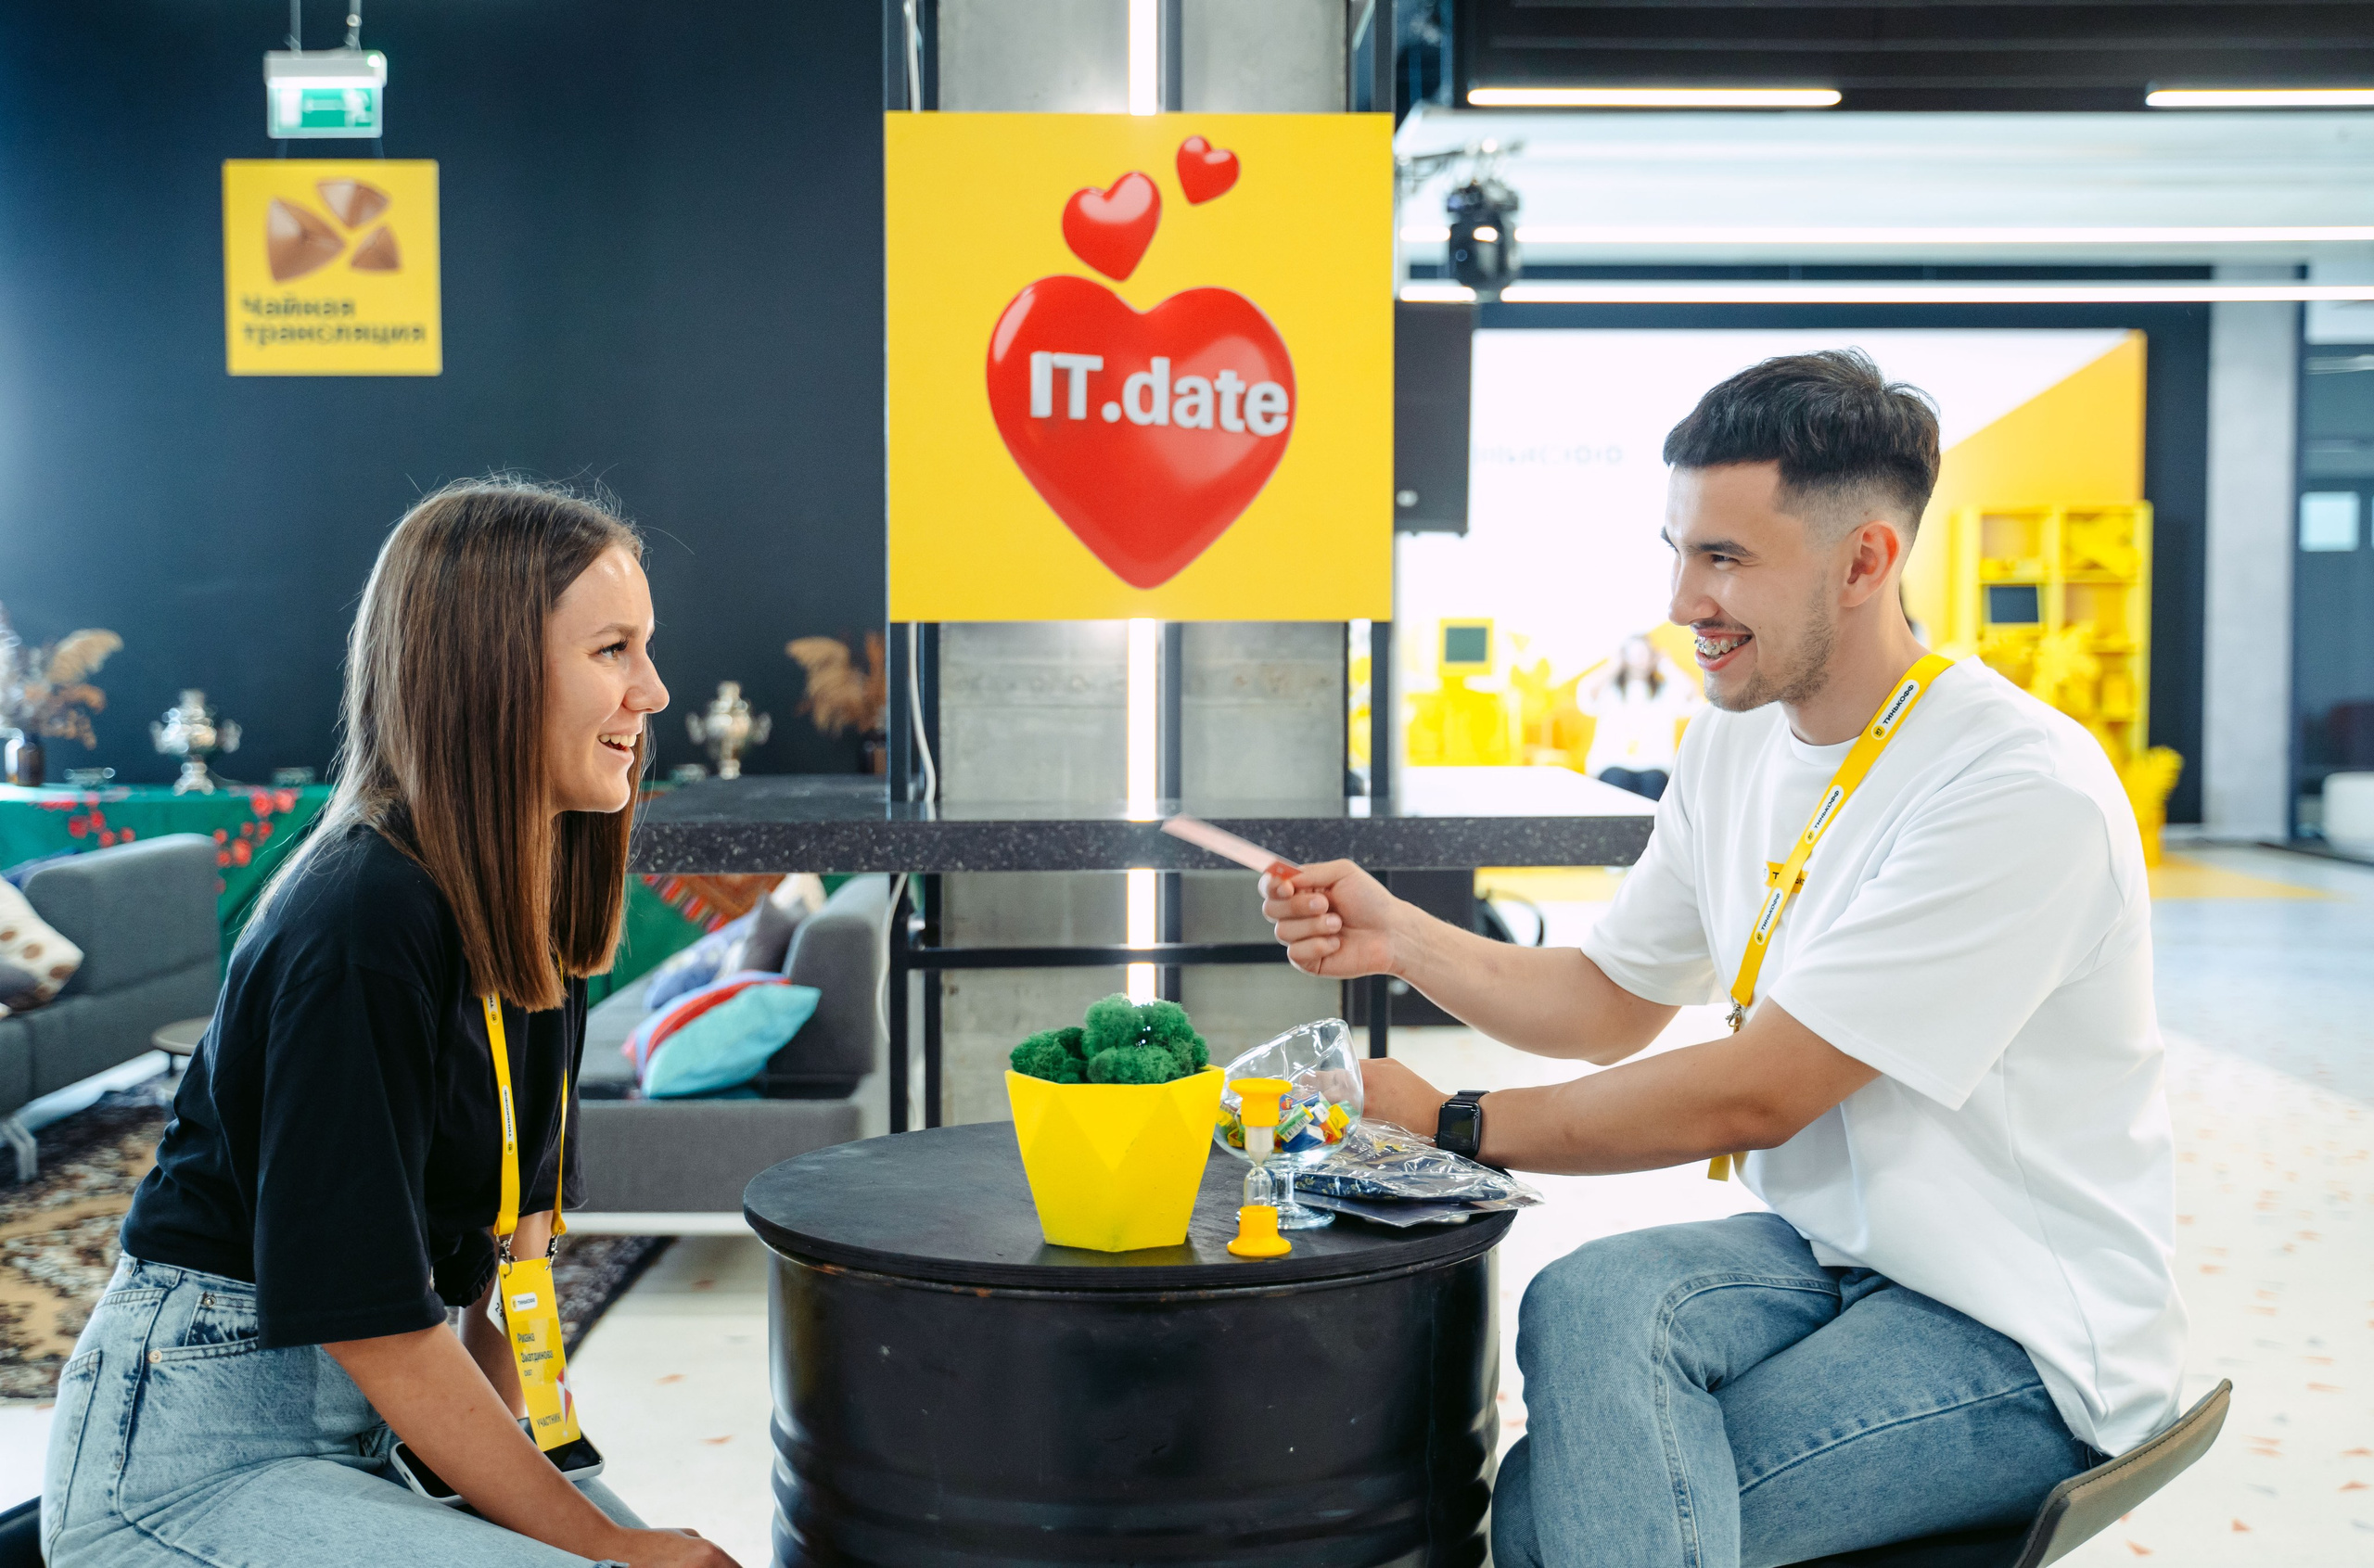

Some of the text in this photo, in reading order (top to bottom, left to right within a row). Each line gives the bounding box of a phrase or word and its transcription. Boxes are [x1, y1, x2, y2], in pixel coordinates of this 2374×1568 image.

[243, 296, 356, 316] Чайная
[244, 325, 426, 348] трансляция
[1030, 351, 1289, 437] IT.date
[1883, 684, 1914, 724] ТИНЬКОФФ
[1814, 790, 1840, 829] ТИНЬКОФФ
[1761, 892, 1780, 931] ТИНЬКОФФ
